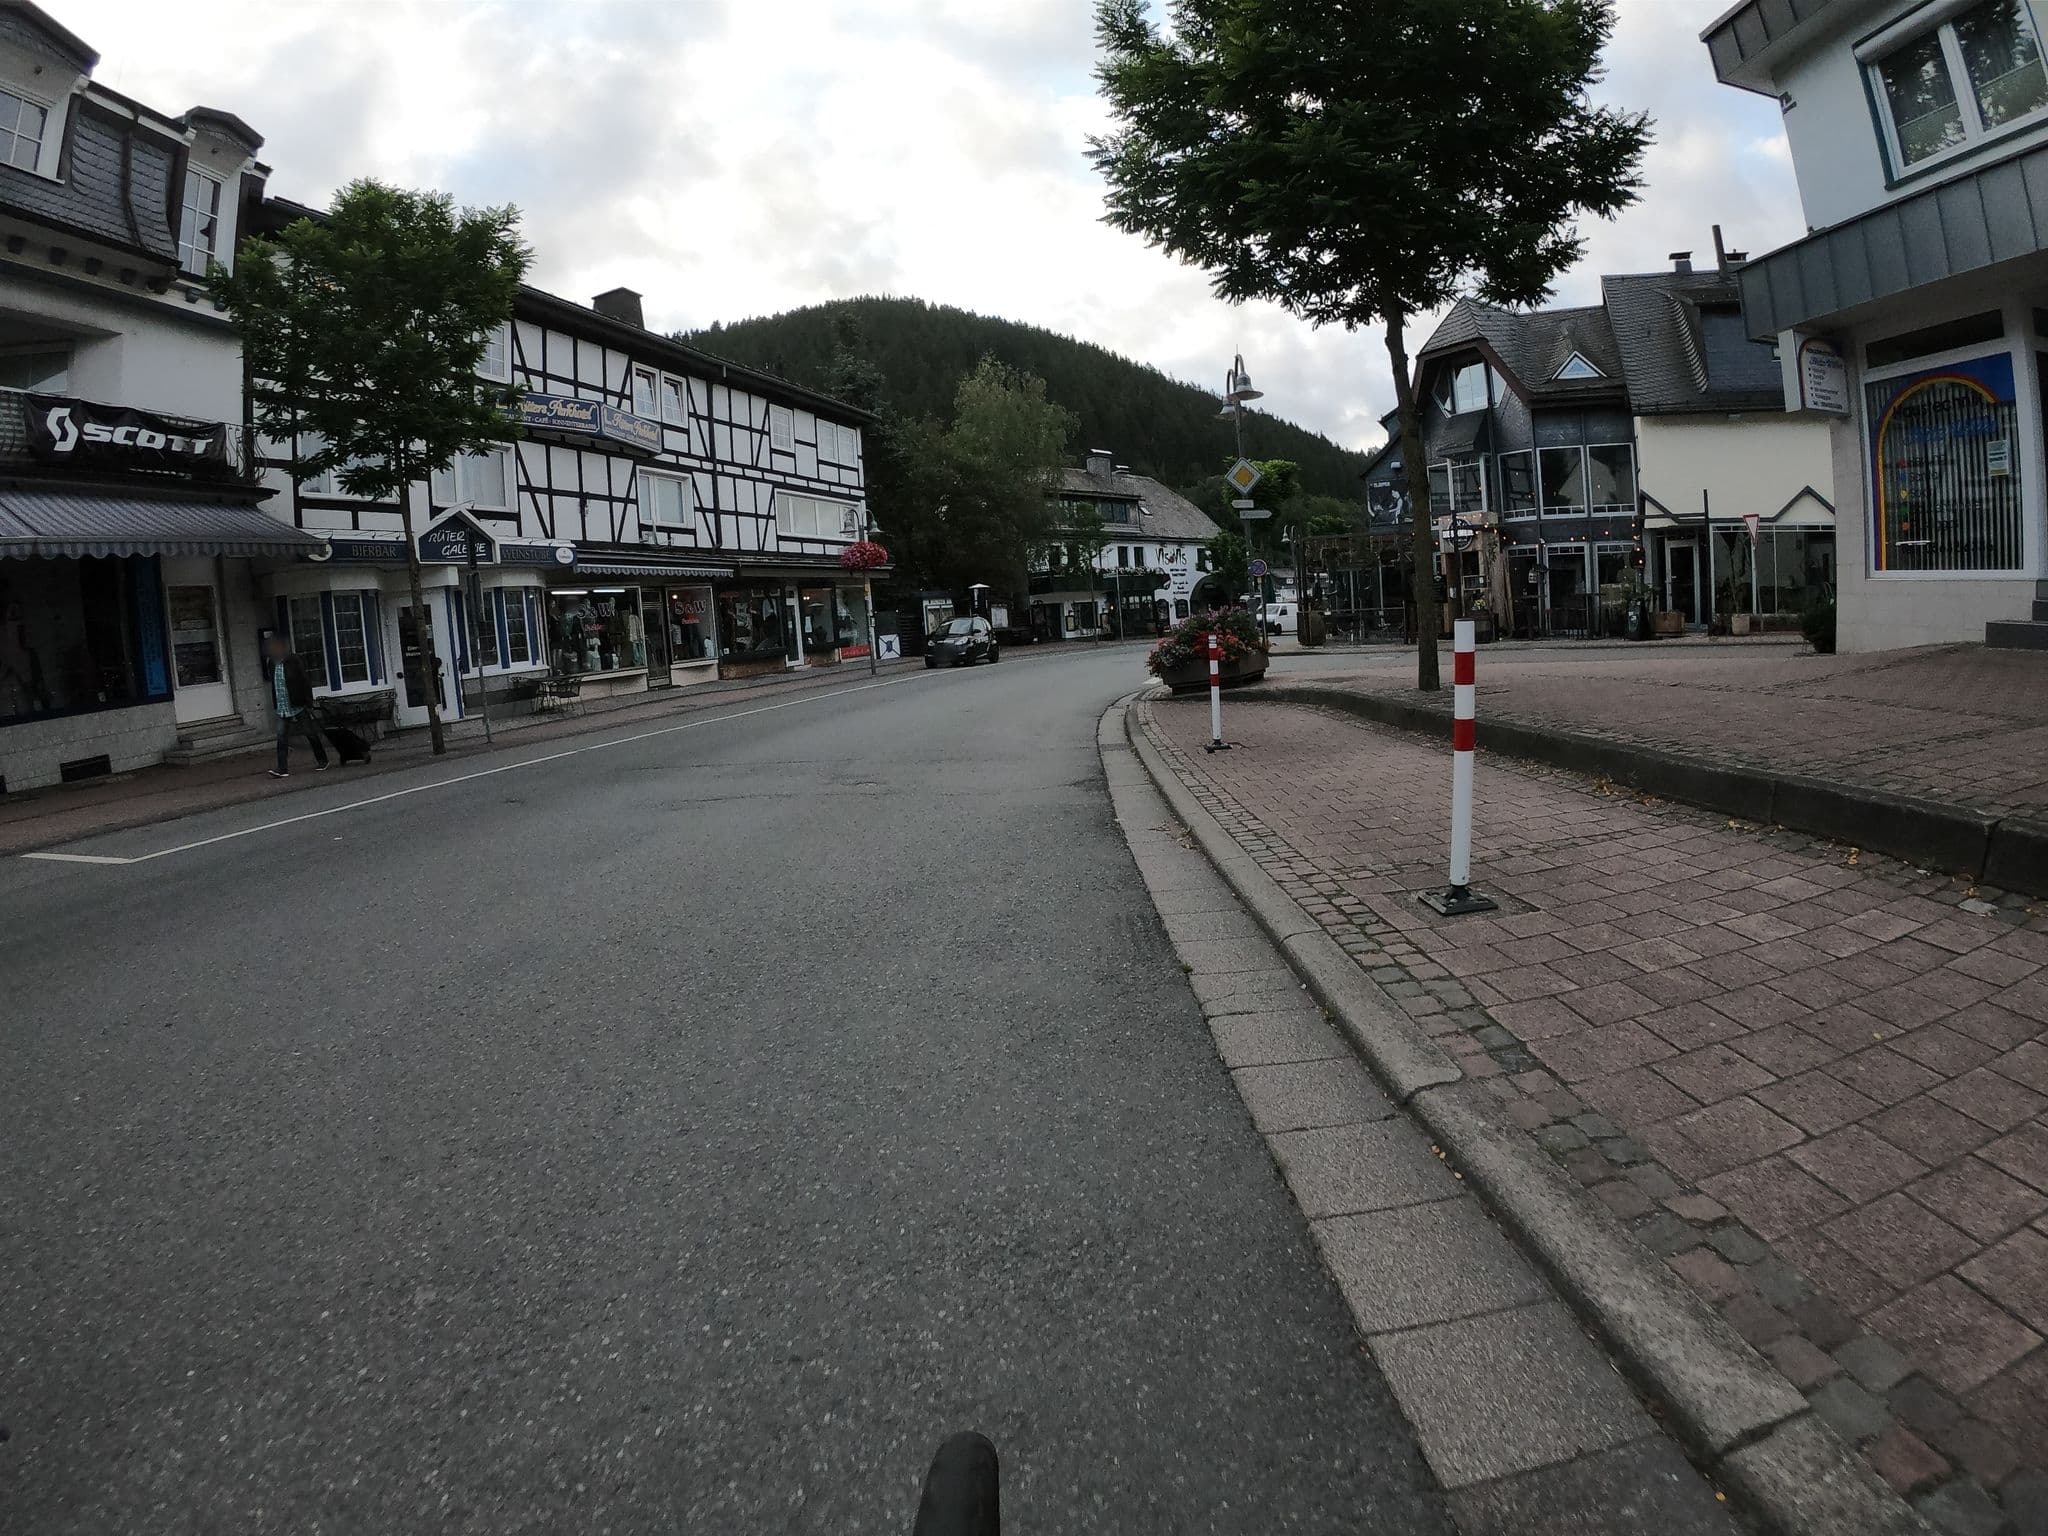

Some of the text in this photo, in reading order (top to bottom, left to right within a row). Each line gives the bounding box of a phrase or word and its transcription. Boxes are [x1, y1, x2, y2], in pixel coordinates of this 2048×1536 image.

[547, 399, 597, 421] Parkhotel
[83, 422, 214, 455] SCOTT
[428, 530, 465, 543] RÜTER
[351, 544, 397, 558] BIERBAR
[441, 543, 487, 556] GALEIE
[502, 548, 551, 561] WEINSTUBE
